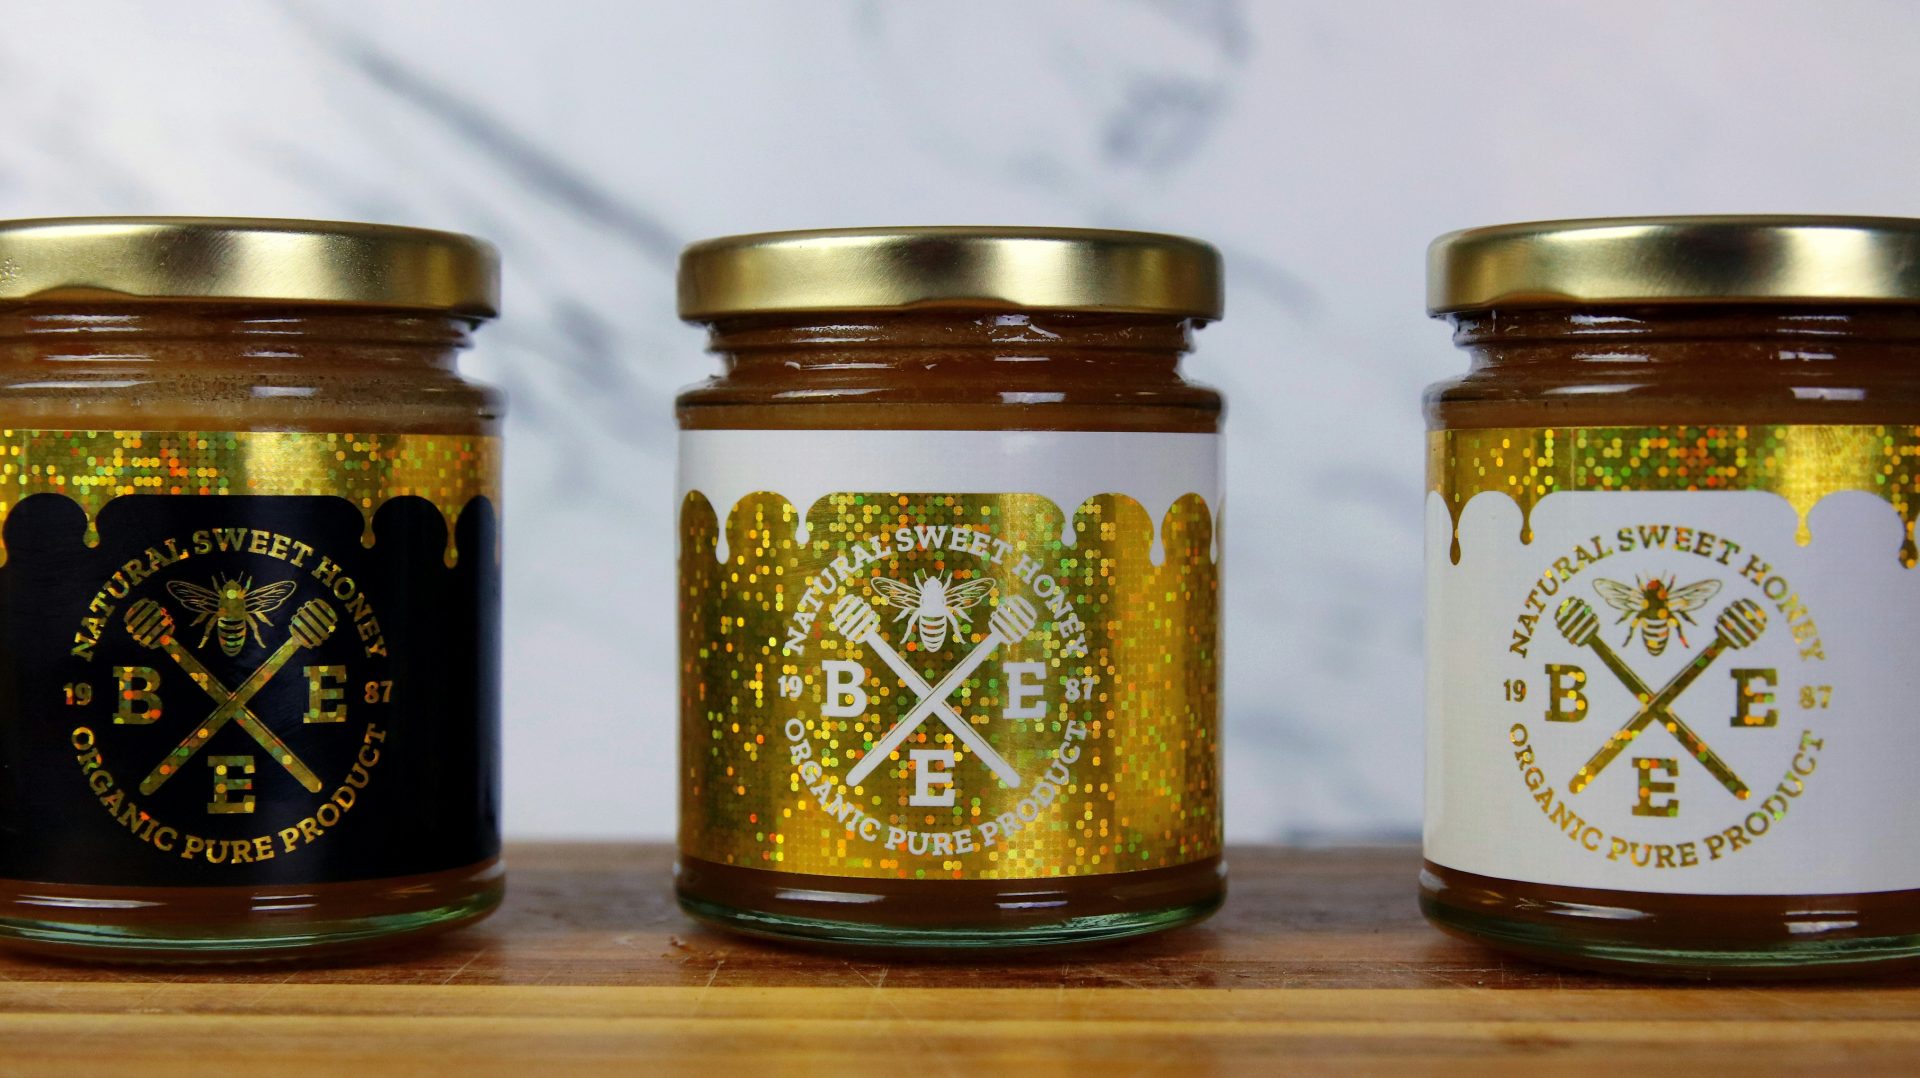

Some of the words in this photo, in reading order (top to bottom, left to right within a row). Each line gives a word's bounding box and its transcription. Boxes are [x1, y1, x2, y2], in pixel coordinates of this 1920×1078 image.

[71, 538, 188, 661] NATURAL
[193, 528, 313, 568] SWEET
[311, 556, 387, 658] HONEY
[785, 535, 891, 655] NATURAL
[896, 525, 1013, 565] SWEET
[1011, 554, 1088, 655] HONEY
[1509, 535, 1613, 658] NATURAL
[1617, 525, 1740, 565] SWEET
[1739, 555, 1825, 661] HONEY
[63, 683, 92, 705] 19
[113, 666, 162, 724] B
[303, 665, 346, 723] E
[364, 681, 393, 703] 87
[778, 675, 803, 697] 19
[821, 660, 867, 717] B
[1002, 662, 1047, 719] E
[1065, 678, 1095, 700] 87
[1504, 679, 1526, 702] 19
[1545, 664, 1589, 722] B
[1730, 668, 1777, 727] E
[1799, 685, 1832, 709] 87
[71, 727, 177, 851] ORGANIC
[181, 835, 274, 864] PURE
[278, 723, 386, 852] PRODUCT
[207, 756, 255, 813] E
[785, 718, 881, 841] ORGANIC
[885, 826, 974, 855] PURE
[978, 720, 1087, 846] PRODUCT
[909, 749, 955, 806] E
[1509, 723, 1603, 851] ORGANIC
[1607, 837, 1698, 868] PURE
[1704, 730, 1823, 859] PRODUCT
[1632, 757, 1679, 817] E
